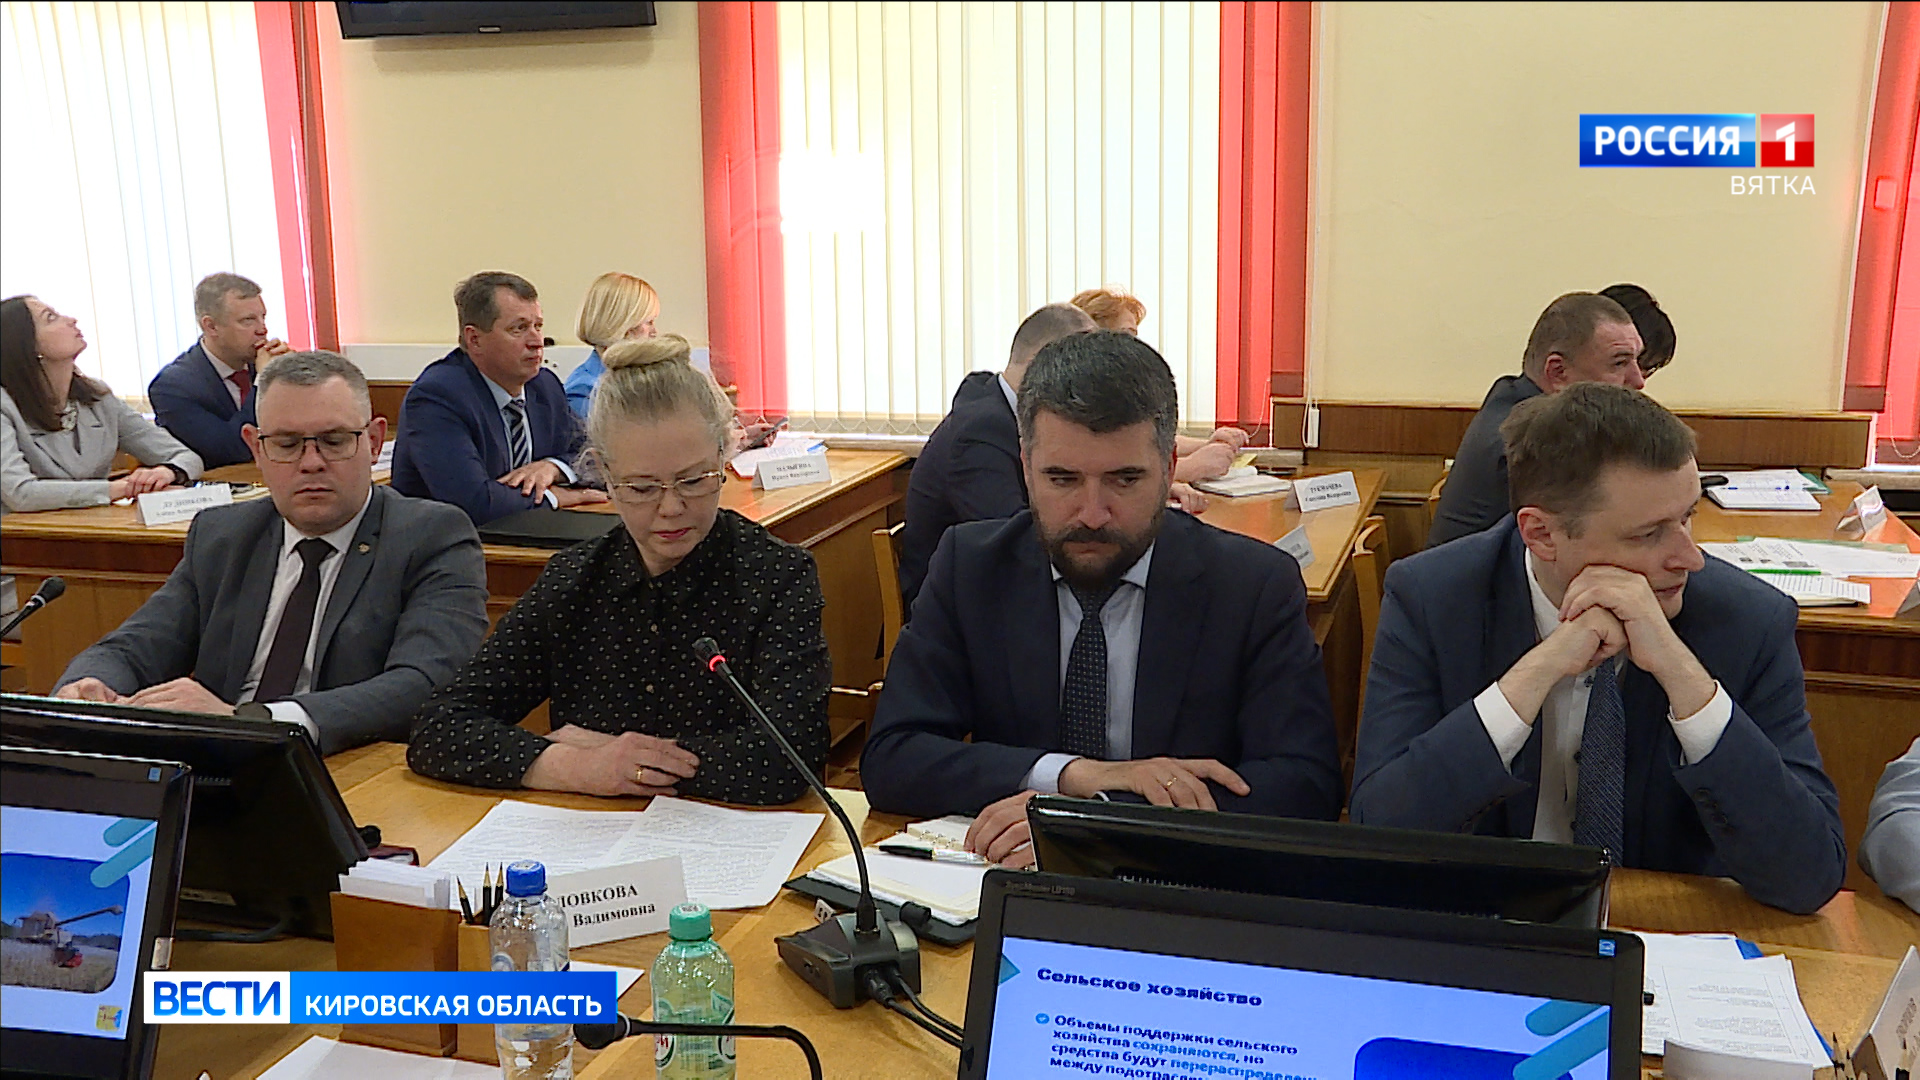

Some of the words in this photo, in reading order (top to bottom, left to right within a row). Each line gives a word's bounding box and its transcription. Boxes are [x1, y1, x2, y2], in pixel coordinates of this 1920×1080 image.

[573, 903, 656, 928] Вадимовна
[1037, 967, 1141, 993] Сельское
[1146, 986, 1263, 1007] хозяйство
[1052, 1029, 1131, 1049] хозяйства
[1132, 1040, 1240, 1064] сохраняются,
[1242, 1054, 1265, 1065] но
[1054, 1014, 1120, 1033] Объемы
[1122, 1023, 1215, 1045] поддержки
[1217, 1037, 1298, 1055] сельского
[1049, 1056, 1104, 1075] между
[1050, 1042, 1120, 1061] средства
[1121, 1050, 1168, 1069] будут
